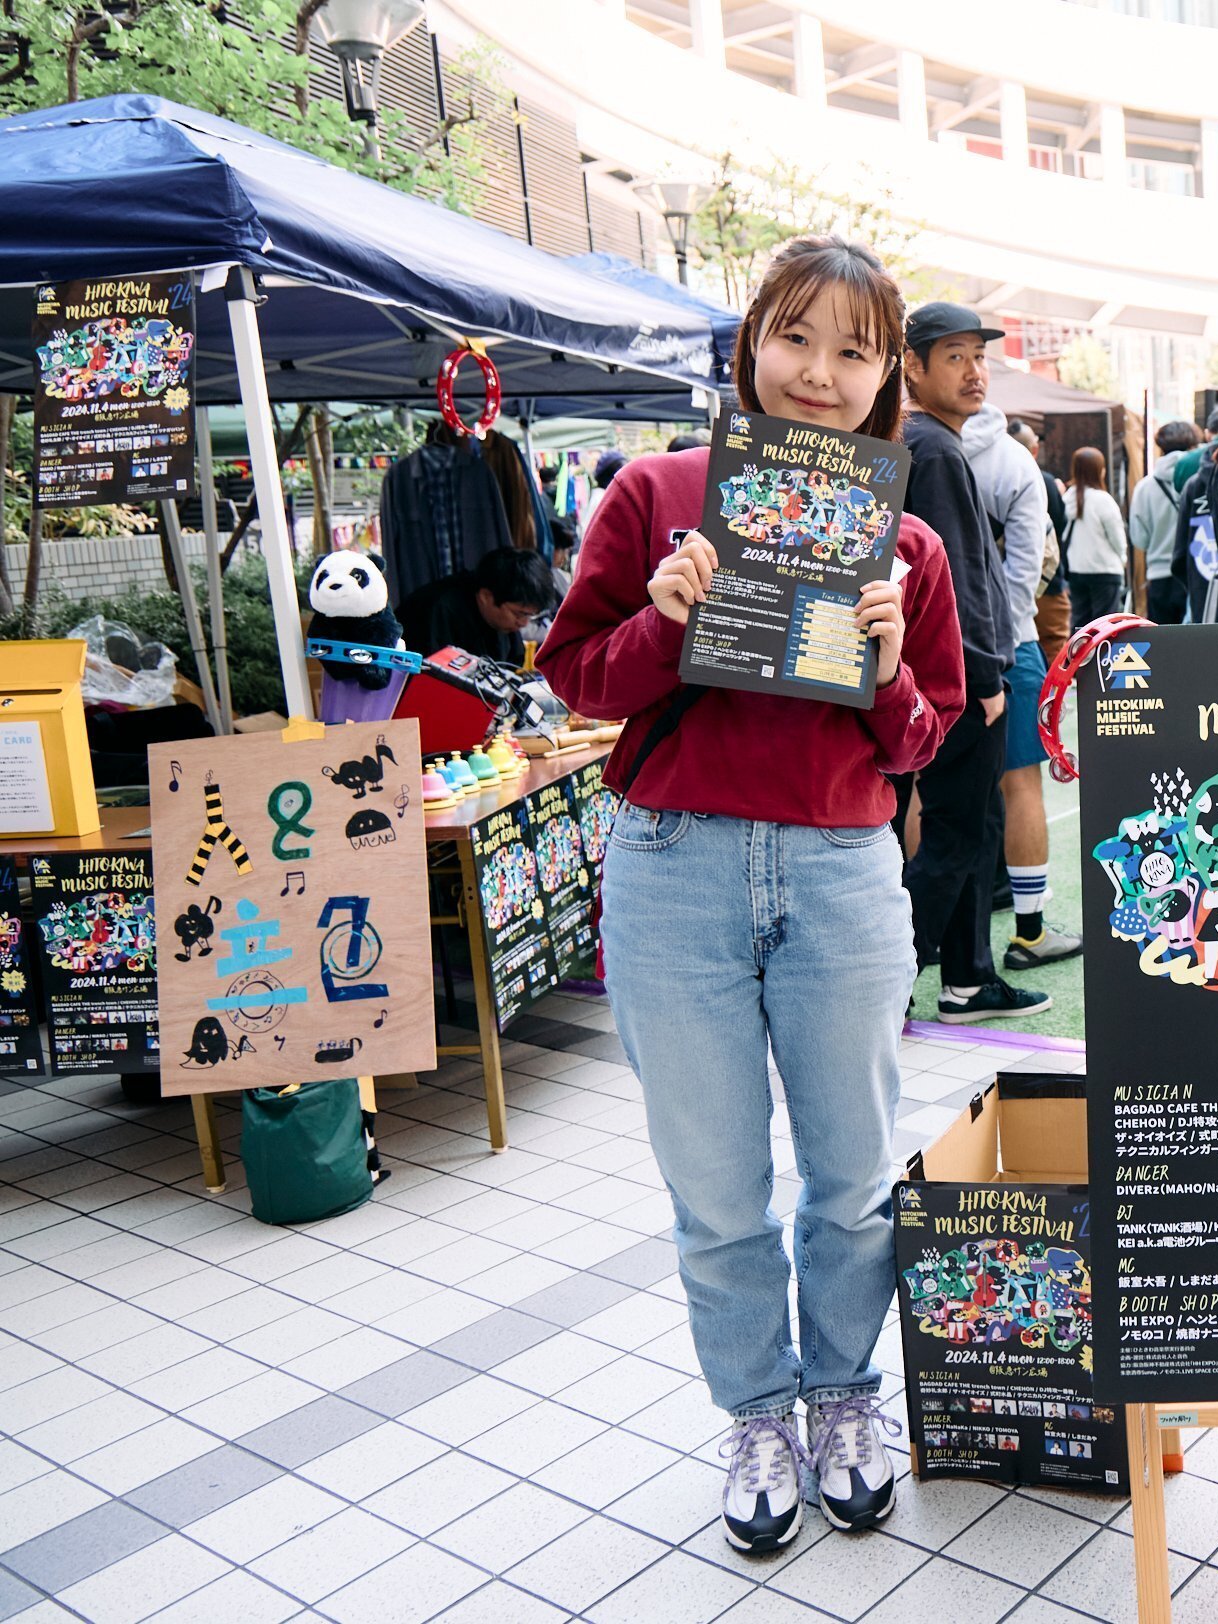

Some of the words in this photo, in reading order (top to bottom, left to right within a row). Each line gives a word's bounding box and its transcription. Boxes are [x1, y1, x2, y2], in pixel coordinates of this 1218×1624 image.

[85, 281, 150, 301] HITOKIWA
[66, 300, 113, 319] MUSIC
[116, 297, 169, 315] FESTIVAL
[786, 428, 856, 461] HITOKIWA
[762, 444, 814, 464] MUSIC
[816, 453, 873, 484] FESTIVAL
[741, 547, 800, 568] 2024.11.4
[1096, 698, 1164, 710] HITOKIWA
[1096, 711, 1140, 723] MUSIC
[1096, 723, 1156, 735] FESTIVAL
[4, 736, 33, 745] CARD
[79, 856, 145, 875] HITOKIWA
[61, 875, 109, 892] MUSIC
[70, 976, 116, 988] 2024.11.4
[1114, 1084, 1193, 1101] MUSICIAN
[1114, 1103, 1164, 1115] BAGDAD
[1167, 1103, 1198, 1114] CAFE
[1114, 1118, 1166, 1129] CHEHON
[1115, 1130, 1187, 1142] ザ・オイオイズ
[1116, 1165, 1169, 1181] DANCER
[958, 1190, 1047, 1214] HITOKIWA
[1117, 1205, 1133, 1220] DJ
[935, 1215, 998, 1236] MUSIC
[1002, 1215, 1075, 1242] FESTIVAL
[1117, 1238, 1135, 1248] KEI
[1118, 1257, 1135, 1273] MC
[1119, 1295, 1168, 1312] BOOTH
[1120, 1317, 1137, 1327] HH
[1141, 1315, 1174, 1326] EXPO
[1120, 1330, 1164, 1341] ノモのコ
[945, 1350, 1007, 1364] 2024.11.4
[1008, 1355, 1035, 1363] mon
[1036, 1357, 1075, 1365] 12:00-18:00
